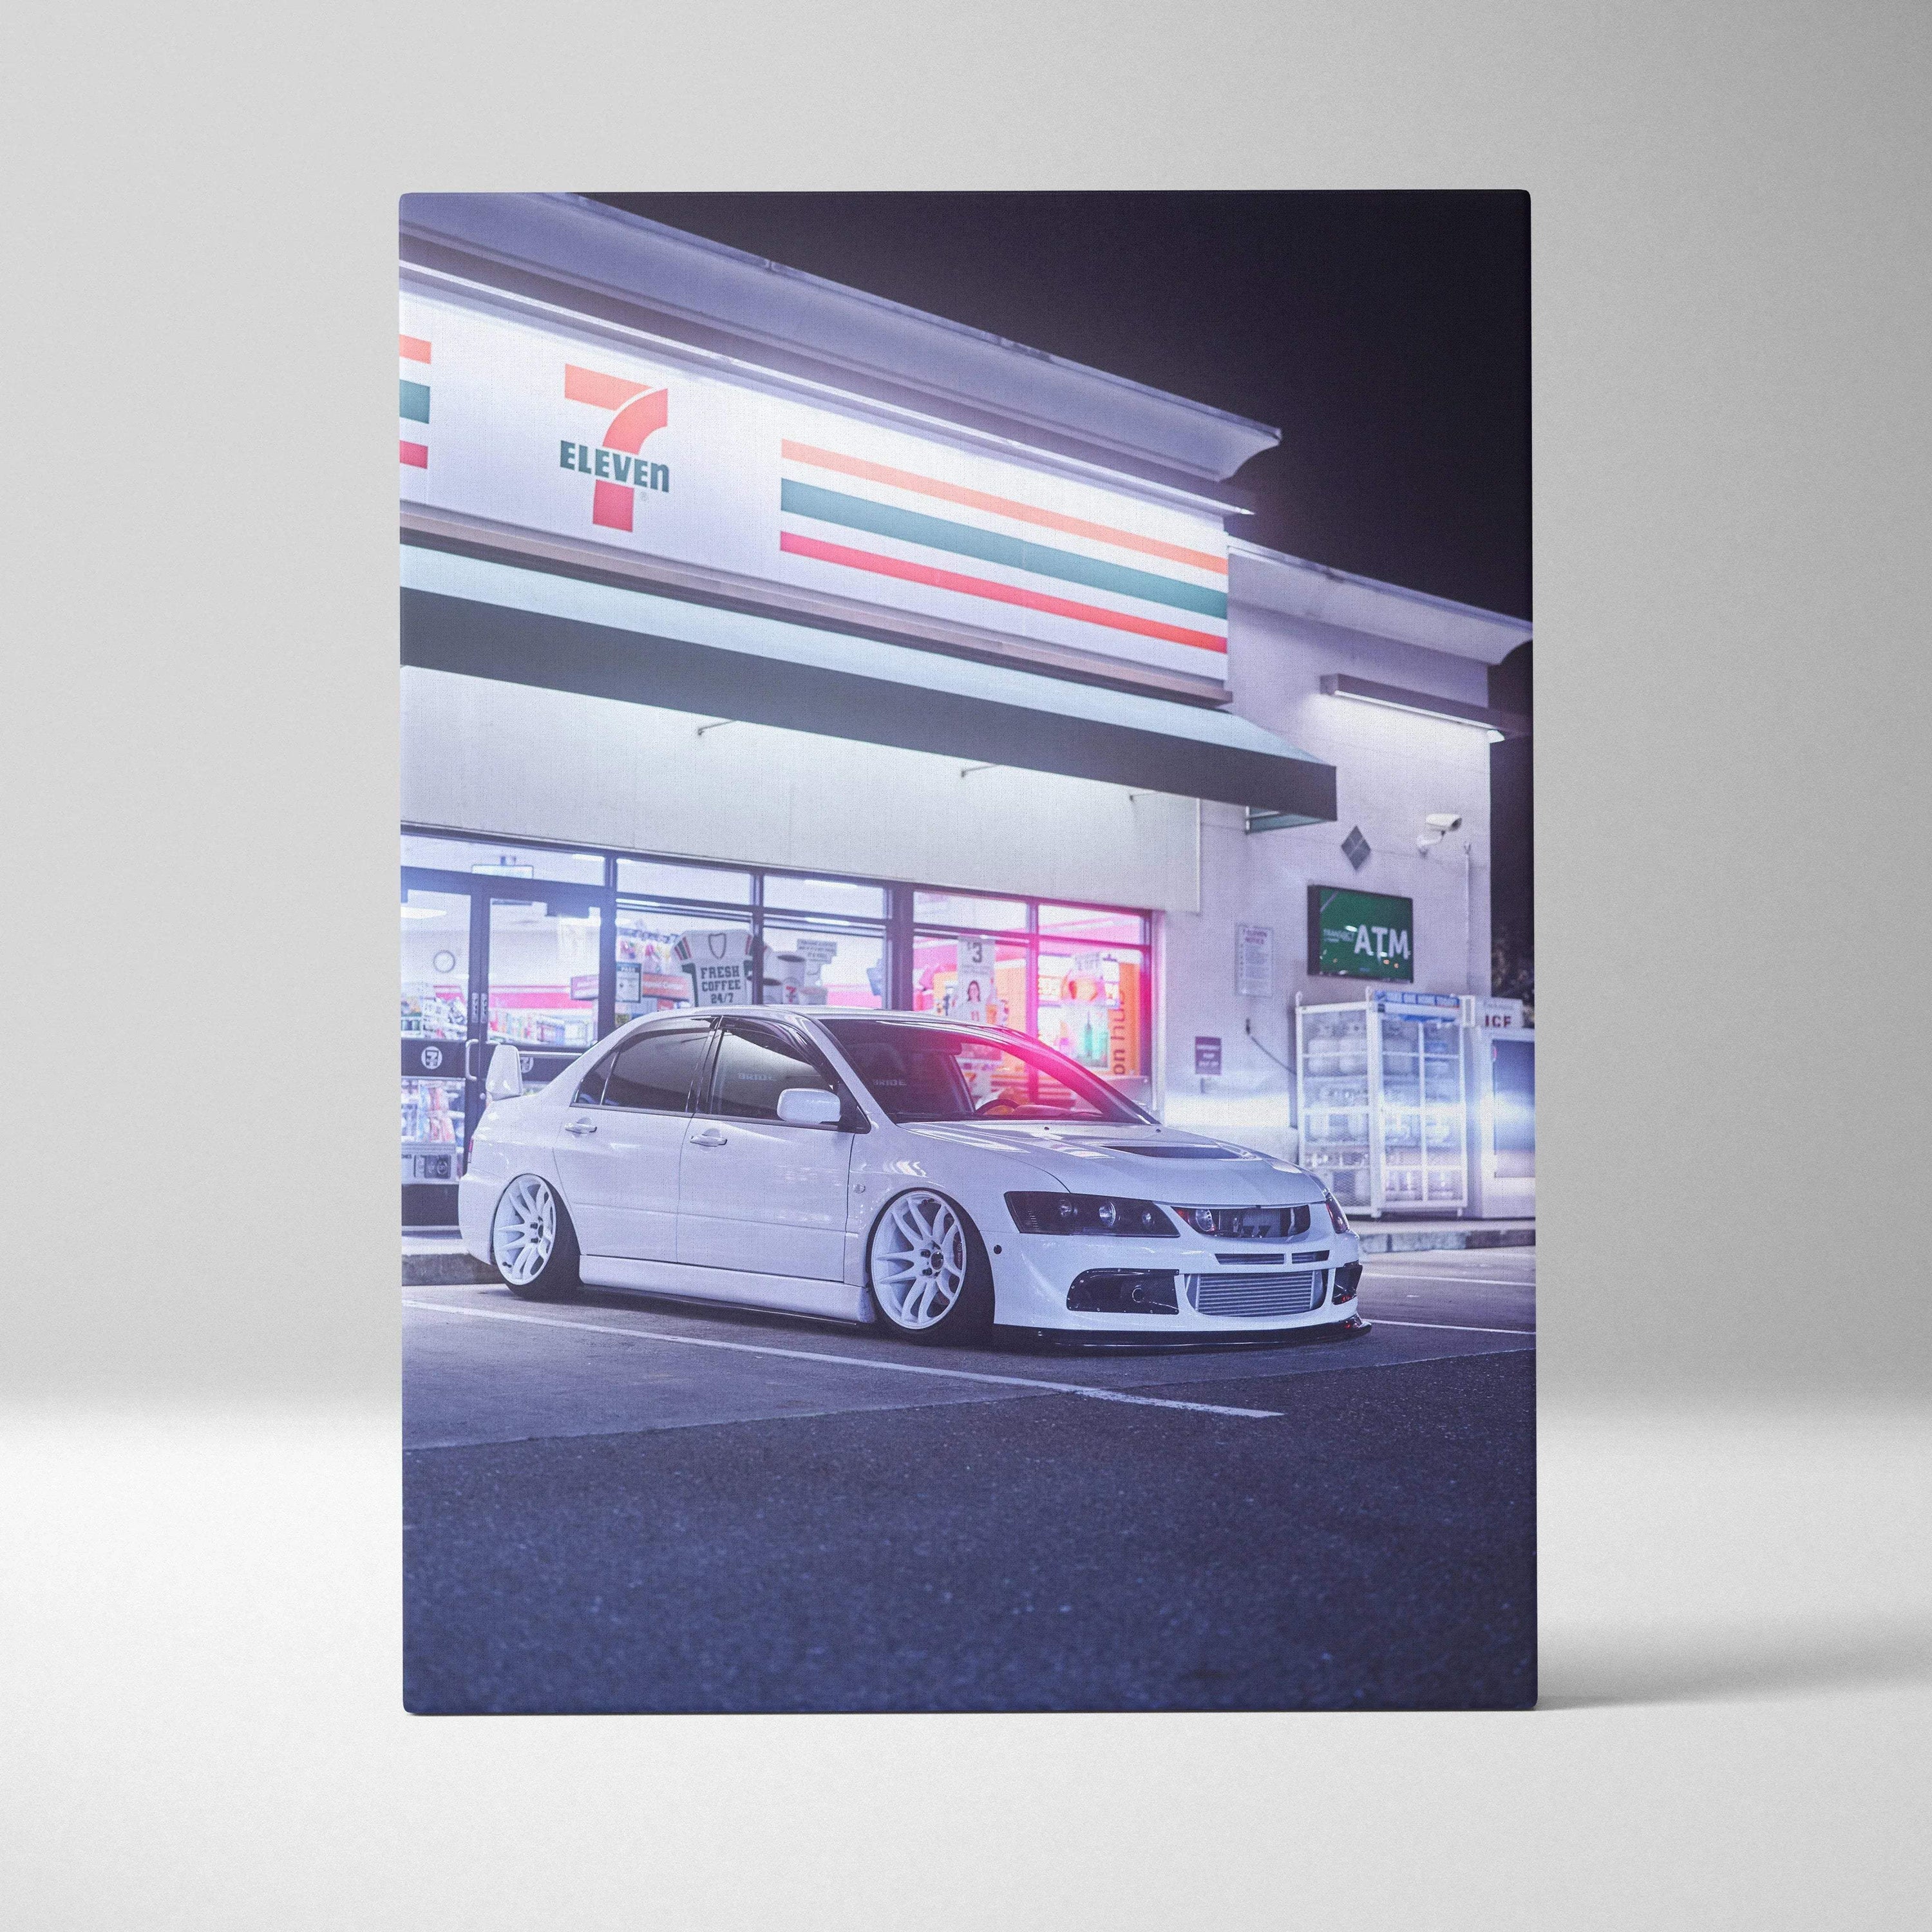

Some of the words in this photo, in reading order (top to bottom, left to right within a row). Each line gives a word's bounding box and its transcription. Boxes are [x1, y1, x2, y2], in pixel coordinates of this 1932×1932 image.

[565, 363, 668, 533] 7
[1354, 924, 1409, 960] ATM
[701, 966, 739, 978] FRESH
[702, 980, 740, 991] COFFEE
[711, 992, 734, 1003] 24/7
